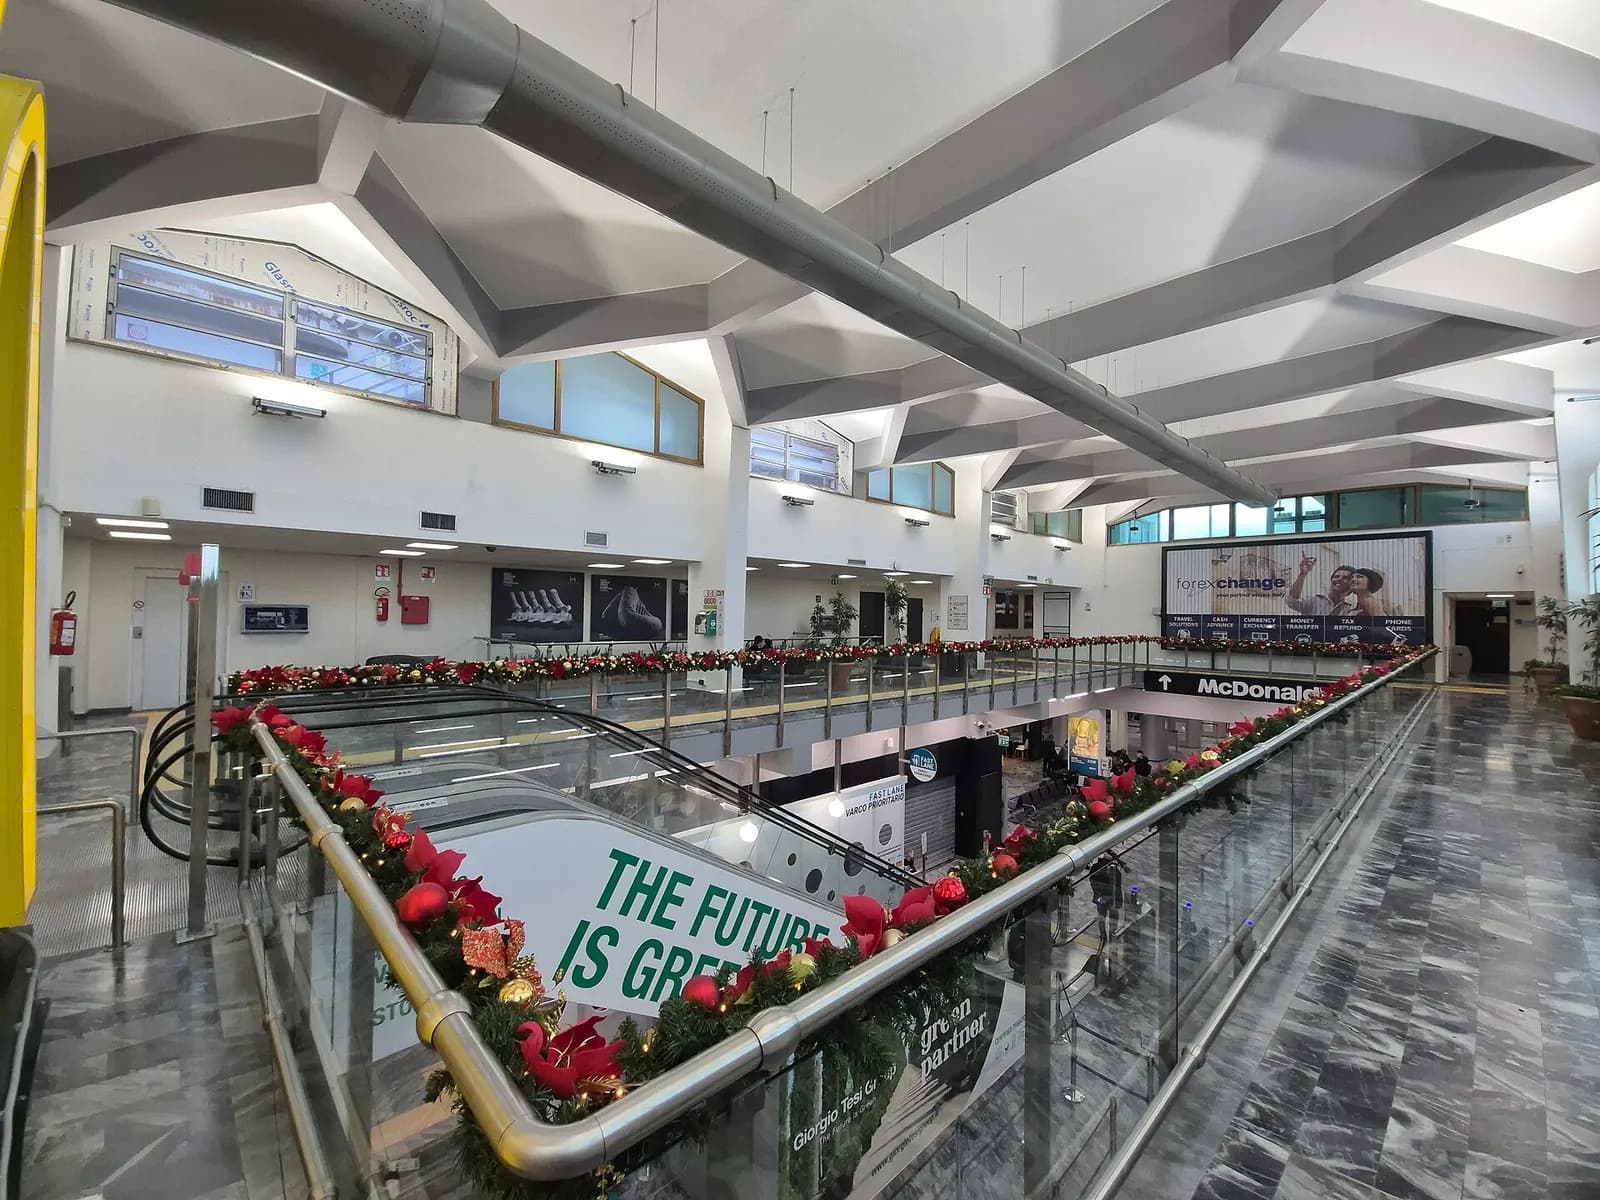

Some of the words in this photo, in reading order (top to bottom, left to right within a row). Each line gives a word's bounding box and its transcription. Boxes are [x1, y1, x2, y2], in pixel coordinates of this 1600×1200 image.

[1176, 576, 1286, 591] forexchange
[1198, 678, 1322, 702] McDonald
[845, 803, 867, 817] VARCO
[868, 793, 905, 811] PRIORITARIO
[869, 789, 886, 801] FAST
[887, 784, 904, 796] LANE
[596, 848, 695, 932] THE
[552, 919, 620, 989] IS
[920, 1011, 987, 1085] partner
[793, 1109, 839, 1152] Giorgio
[840, 1087, 863, 1114] Tesi
